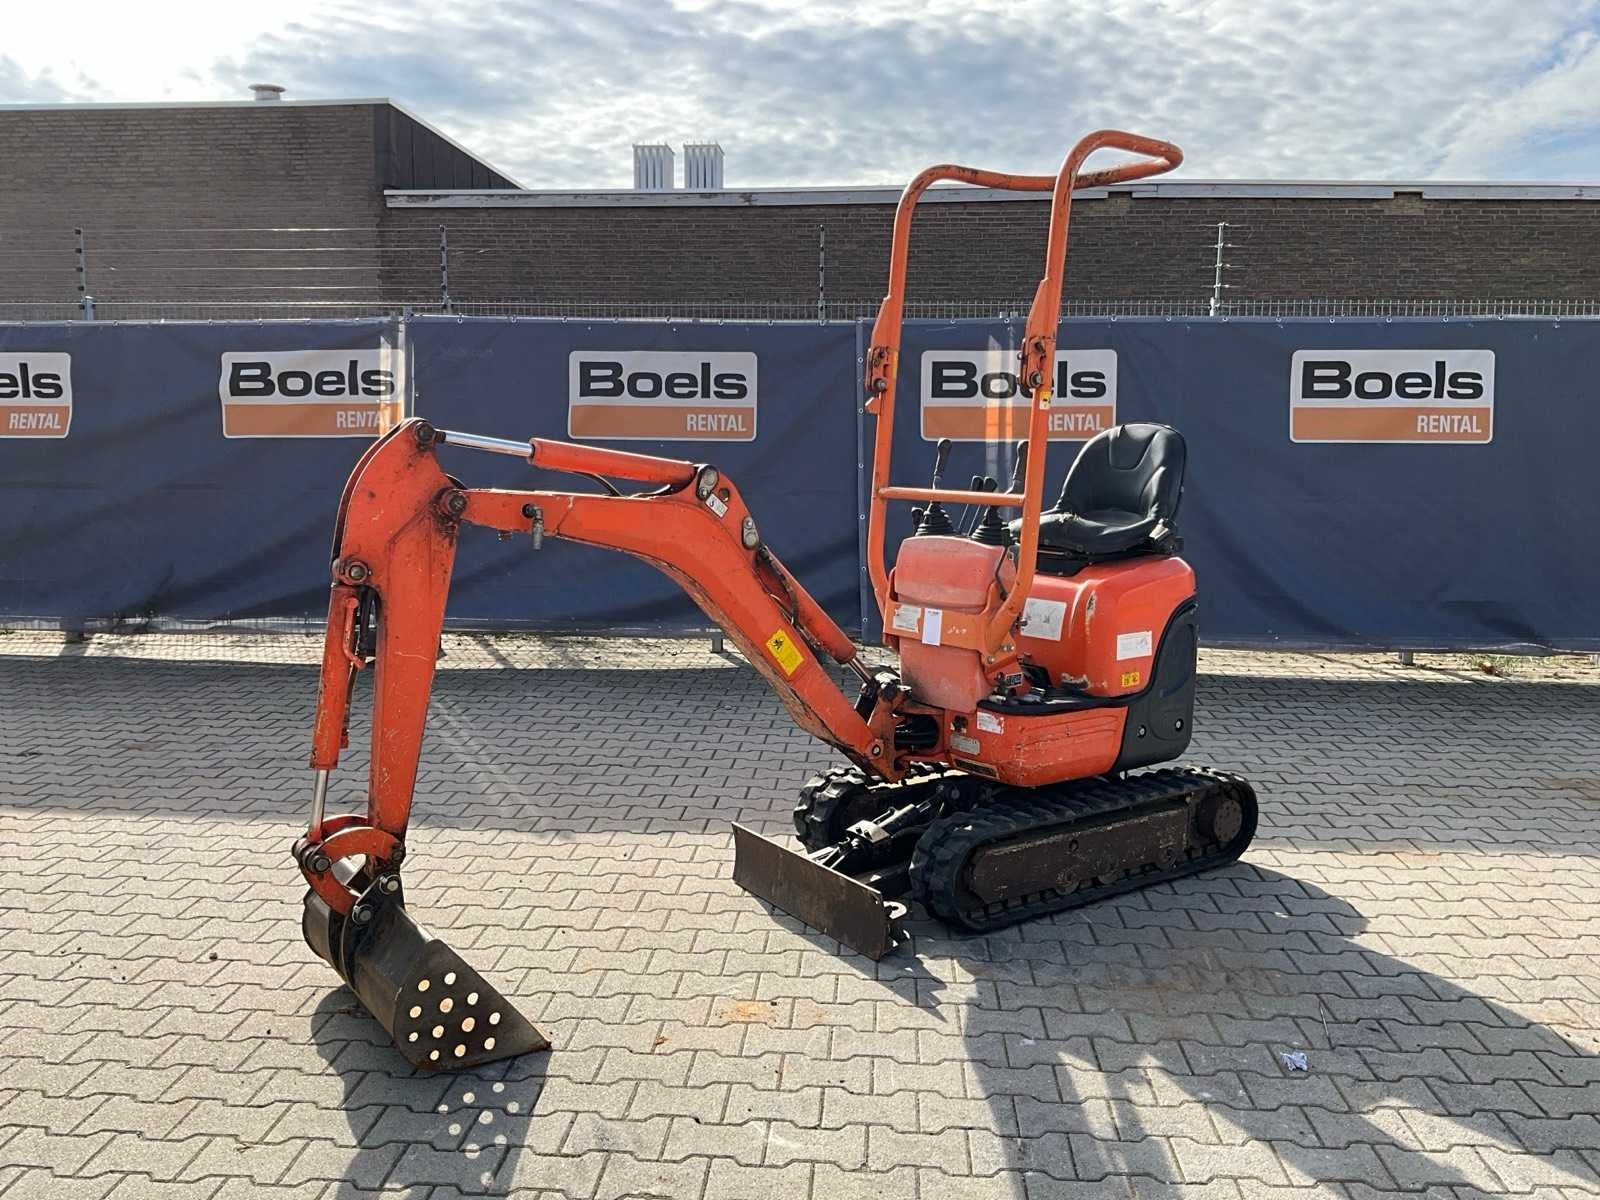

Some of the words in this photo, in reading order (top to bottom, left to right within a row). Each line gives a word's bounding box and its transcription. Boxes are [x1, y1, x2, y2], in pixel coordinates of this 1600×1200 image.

[229, 360, 394, 397] Boels
[579, 361, 748, 400] Boels
[1301, 360, 1484, 400] Boels
[9, 413, 61, 429] RENTAL
[686, 414, 747, 432] RENTAL
[1416, 415, 1482, 433] RENTAL
